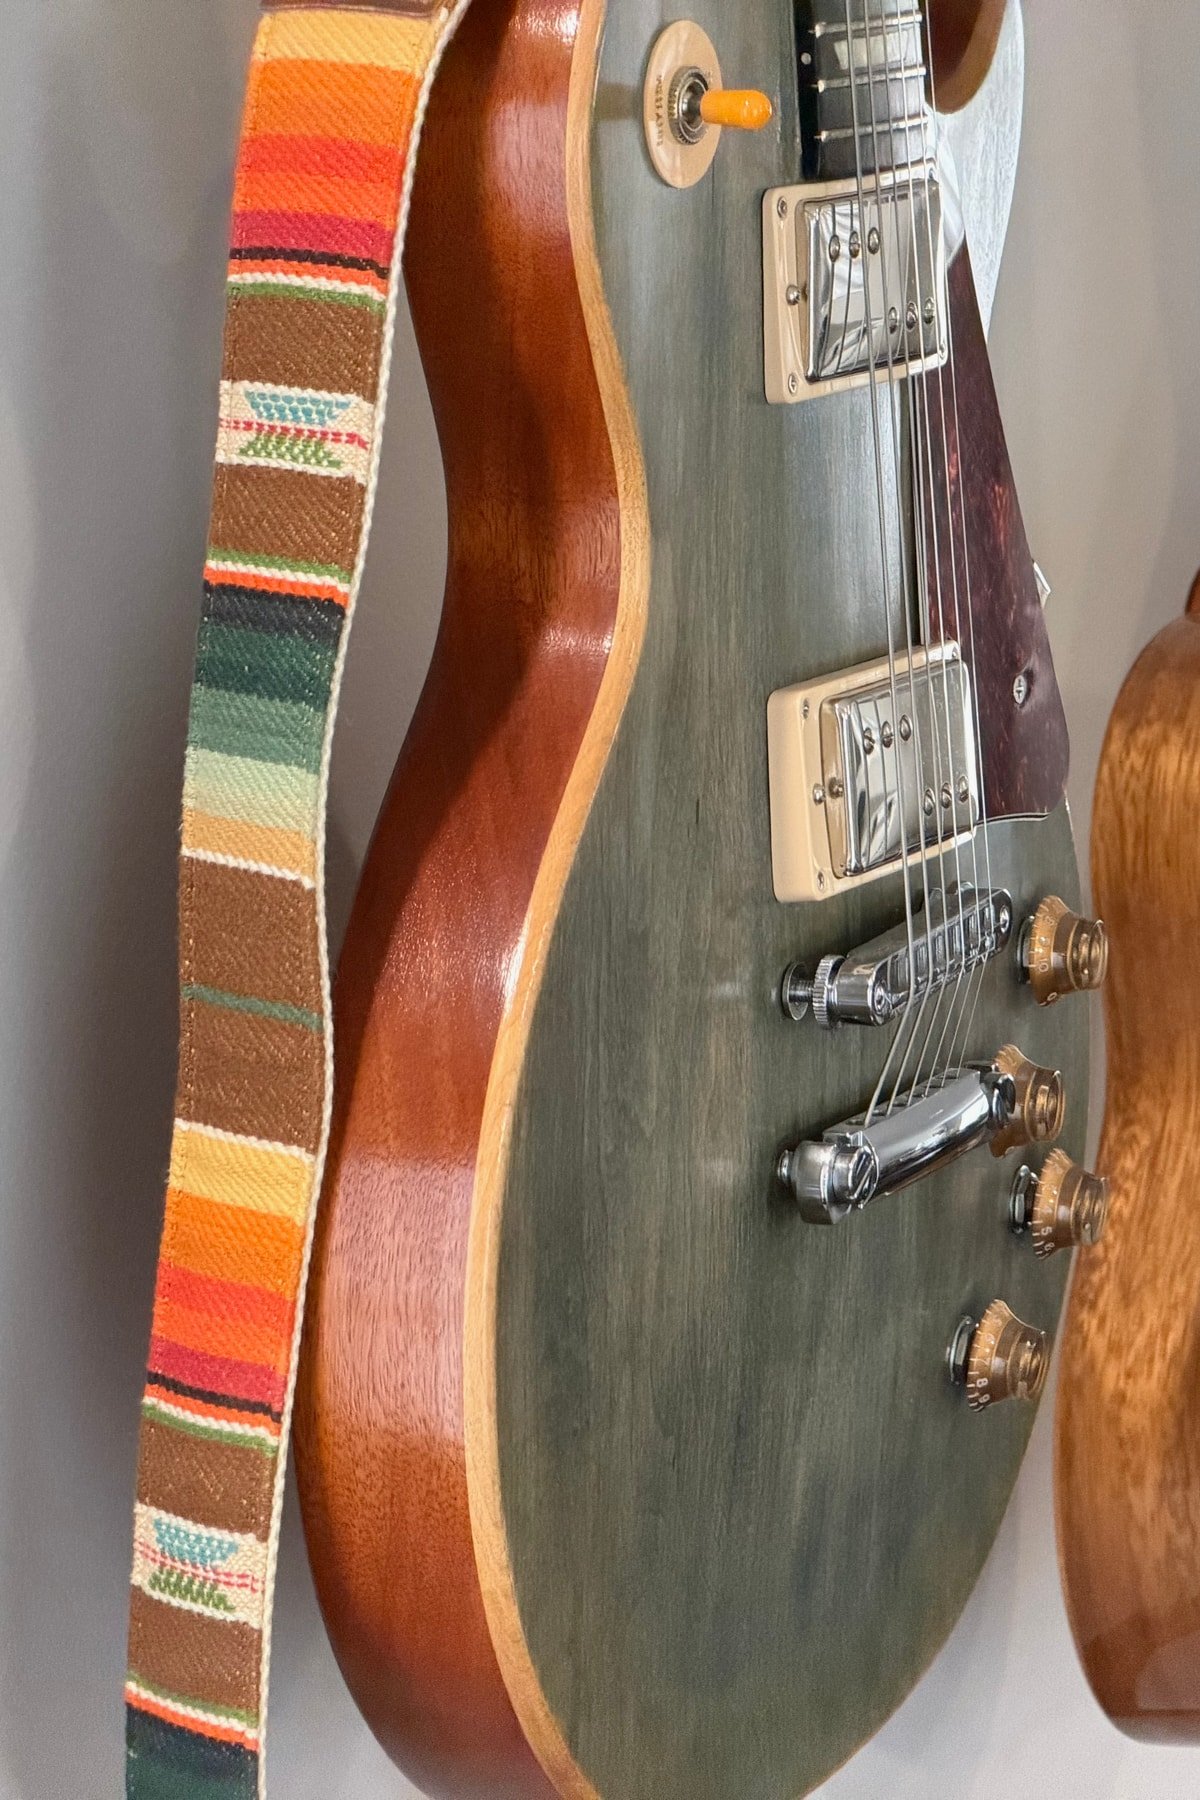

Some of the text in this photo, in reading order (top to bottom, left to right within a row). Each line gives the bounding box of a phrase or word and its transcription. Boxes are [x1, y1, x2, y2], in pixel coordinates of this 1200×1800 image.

[1038, 958, 1049, 973] 10
[1048, 992, 1057, 1002] 0
[1042, 1226, 1053, 1236] 5
[976, 1377, 988, 1388] 8
[978, 1393, 990, 1404] 9
